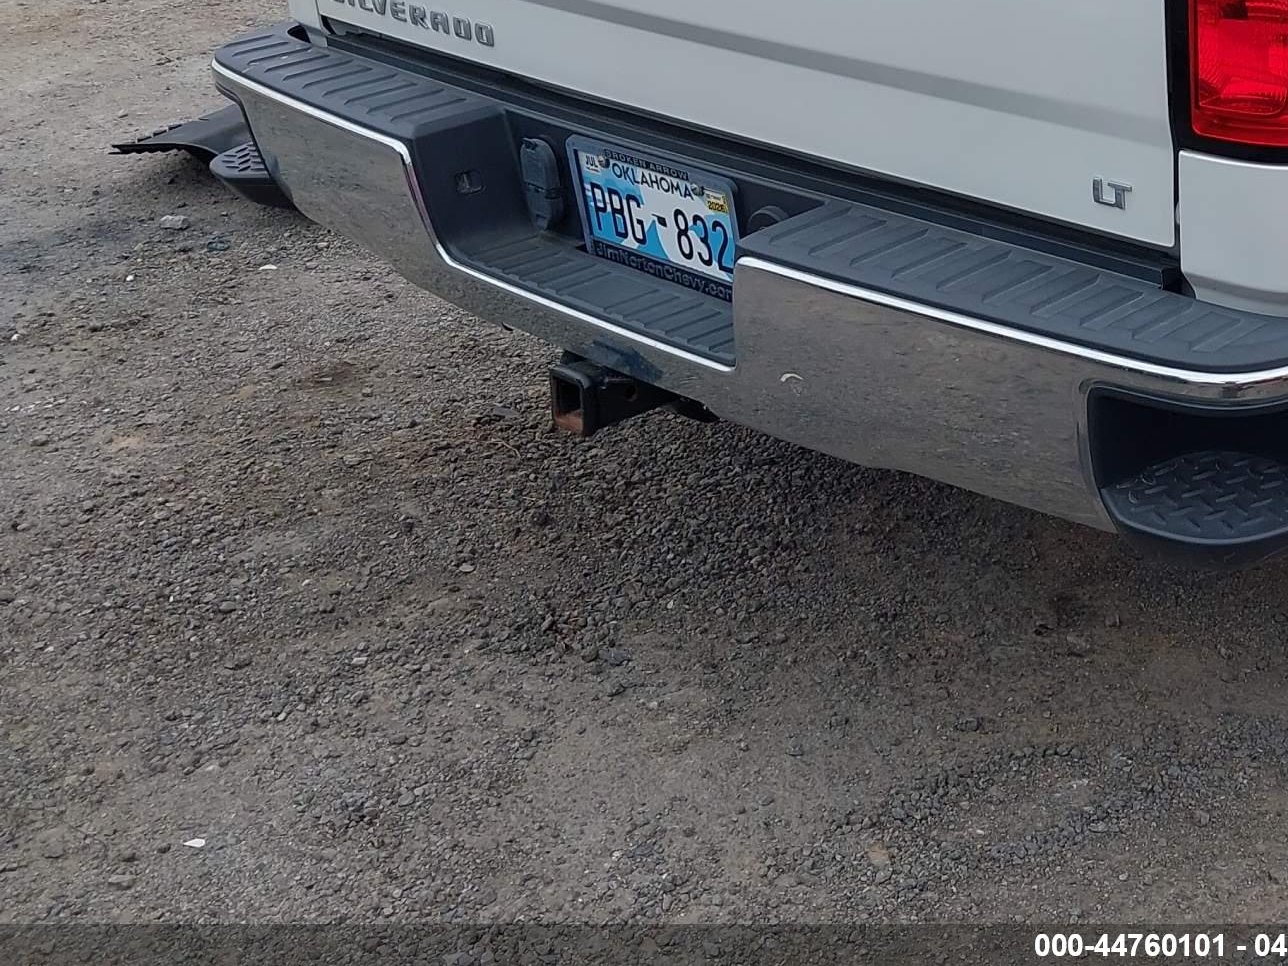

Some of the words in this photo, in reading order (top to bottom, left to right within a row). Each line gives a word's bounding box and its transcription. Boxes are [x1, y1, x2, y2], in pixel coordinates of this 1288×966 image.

[611, 163, 695, 201] OKLAHOMA
[649, 161, 689, 181] ARROW
[1092, 176, 1133, 211] LT
